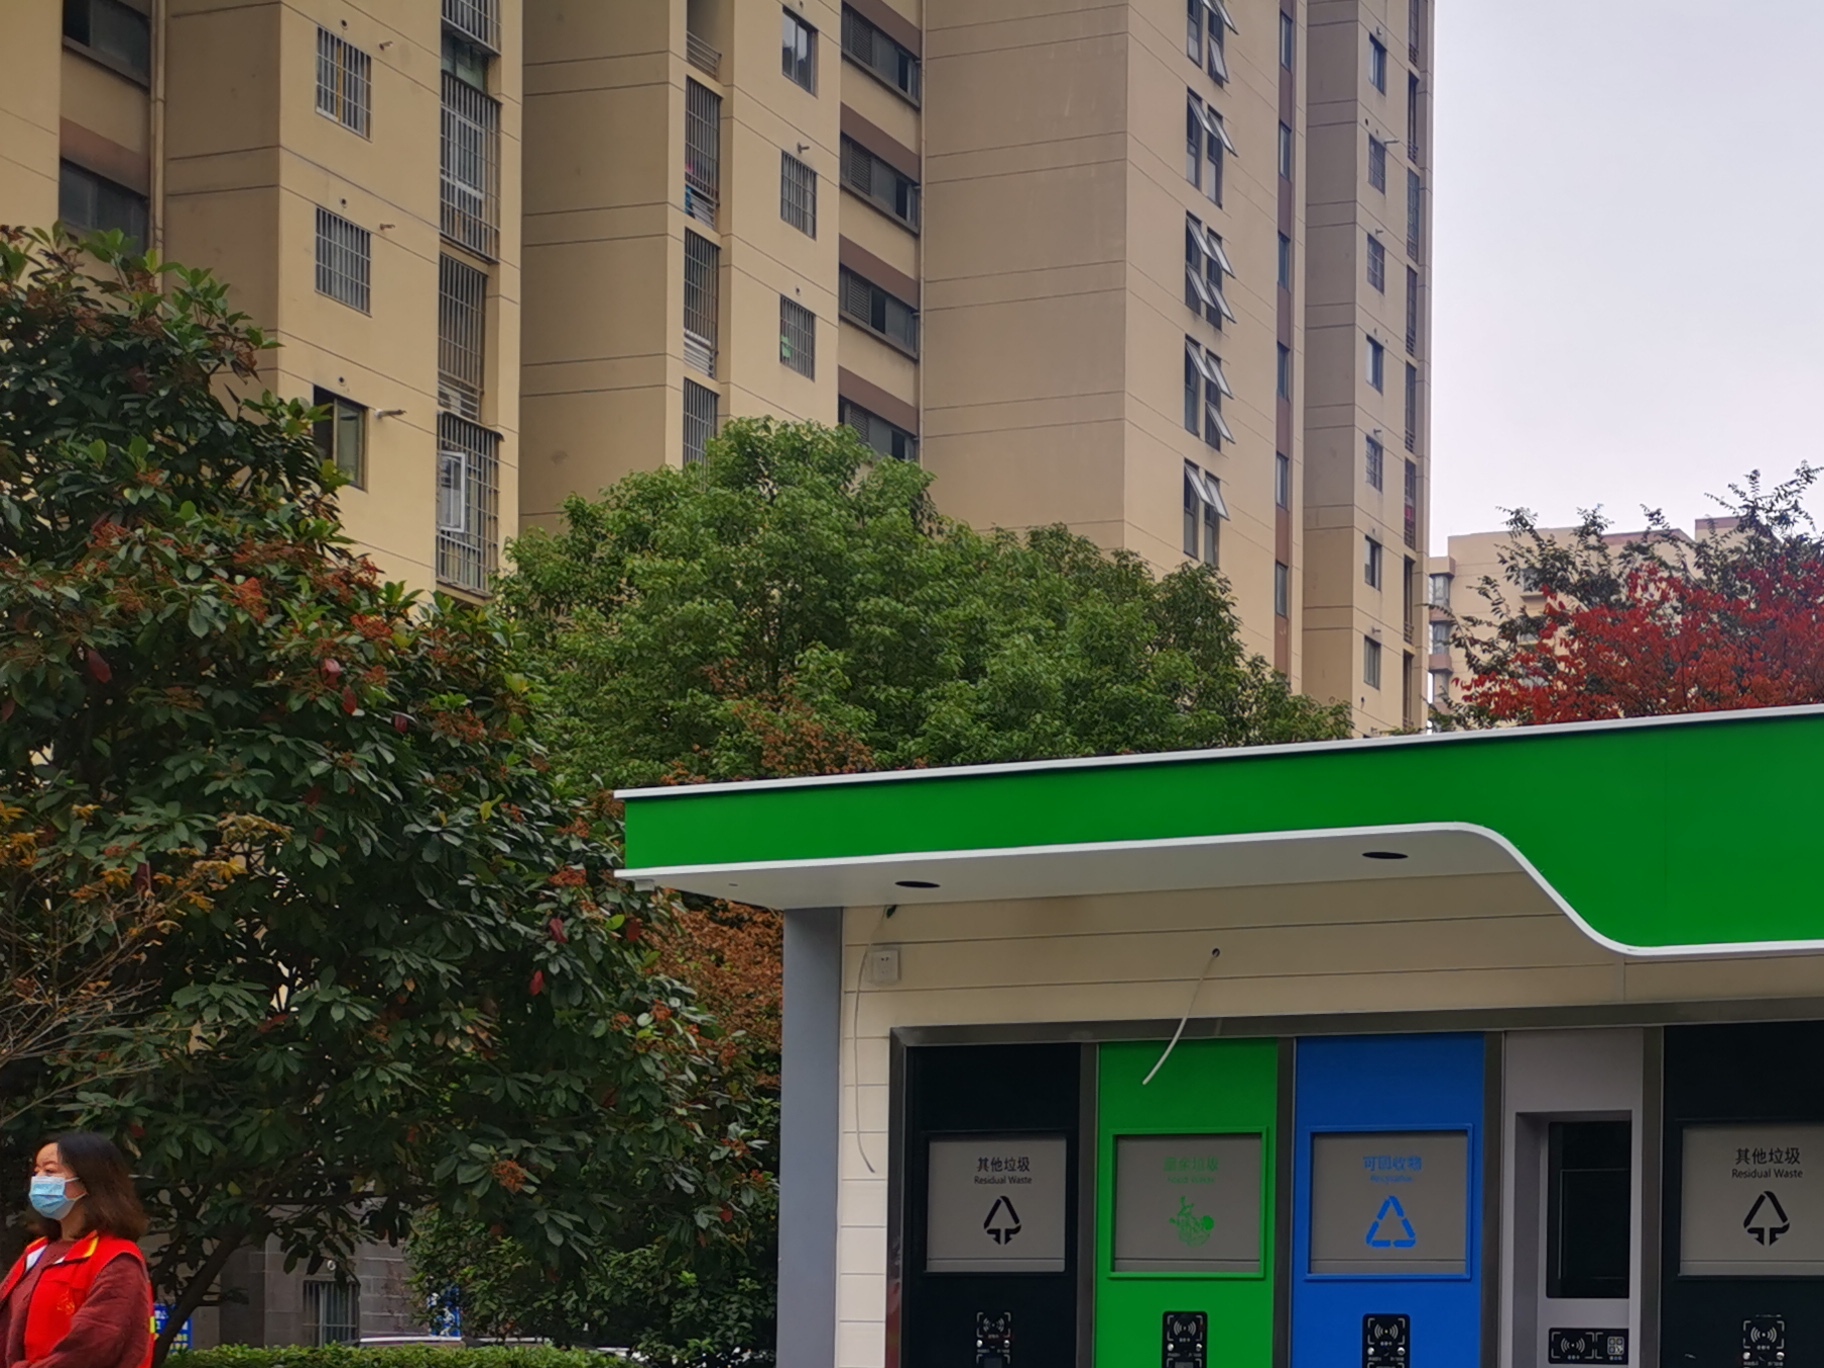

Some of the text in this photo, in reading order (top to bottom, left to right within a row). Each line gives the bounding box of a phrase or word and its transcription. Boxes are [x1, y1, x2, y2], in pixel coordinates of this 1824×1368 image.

[977, 1156, 1030, 1172] 其他垃圾
[1735, 1147, 1801, 1165] 其他垃圾
[1731, 1168, 1803, 1178] Residual Waste
